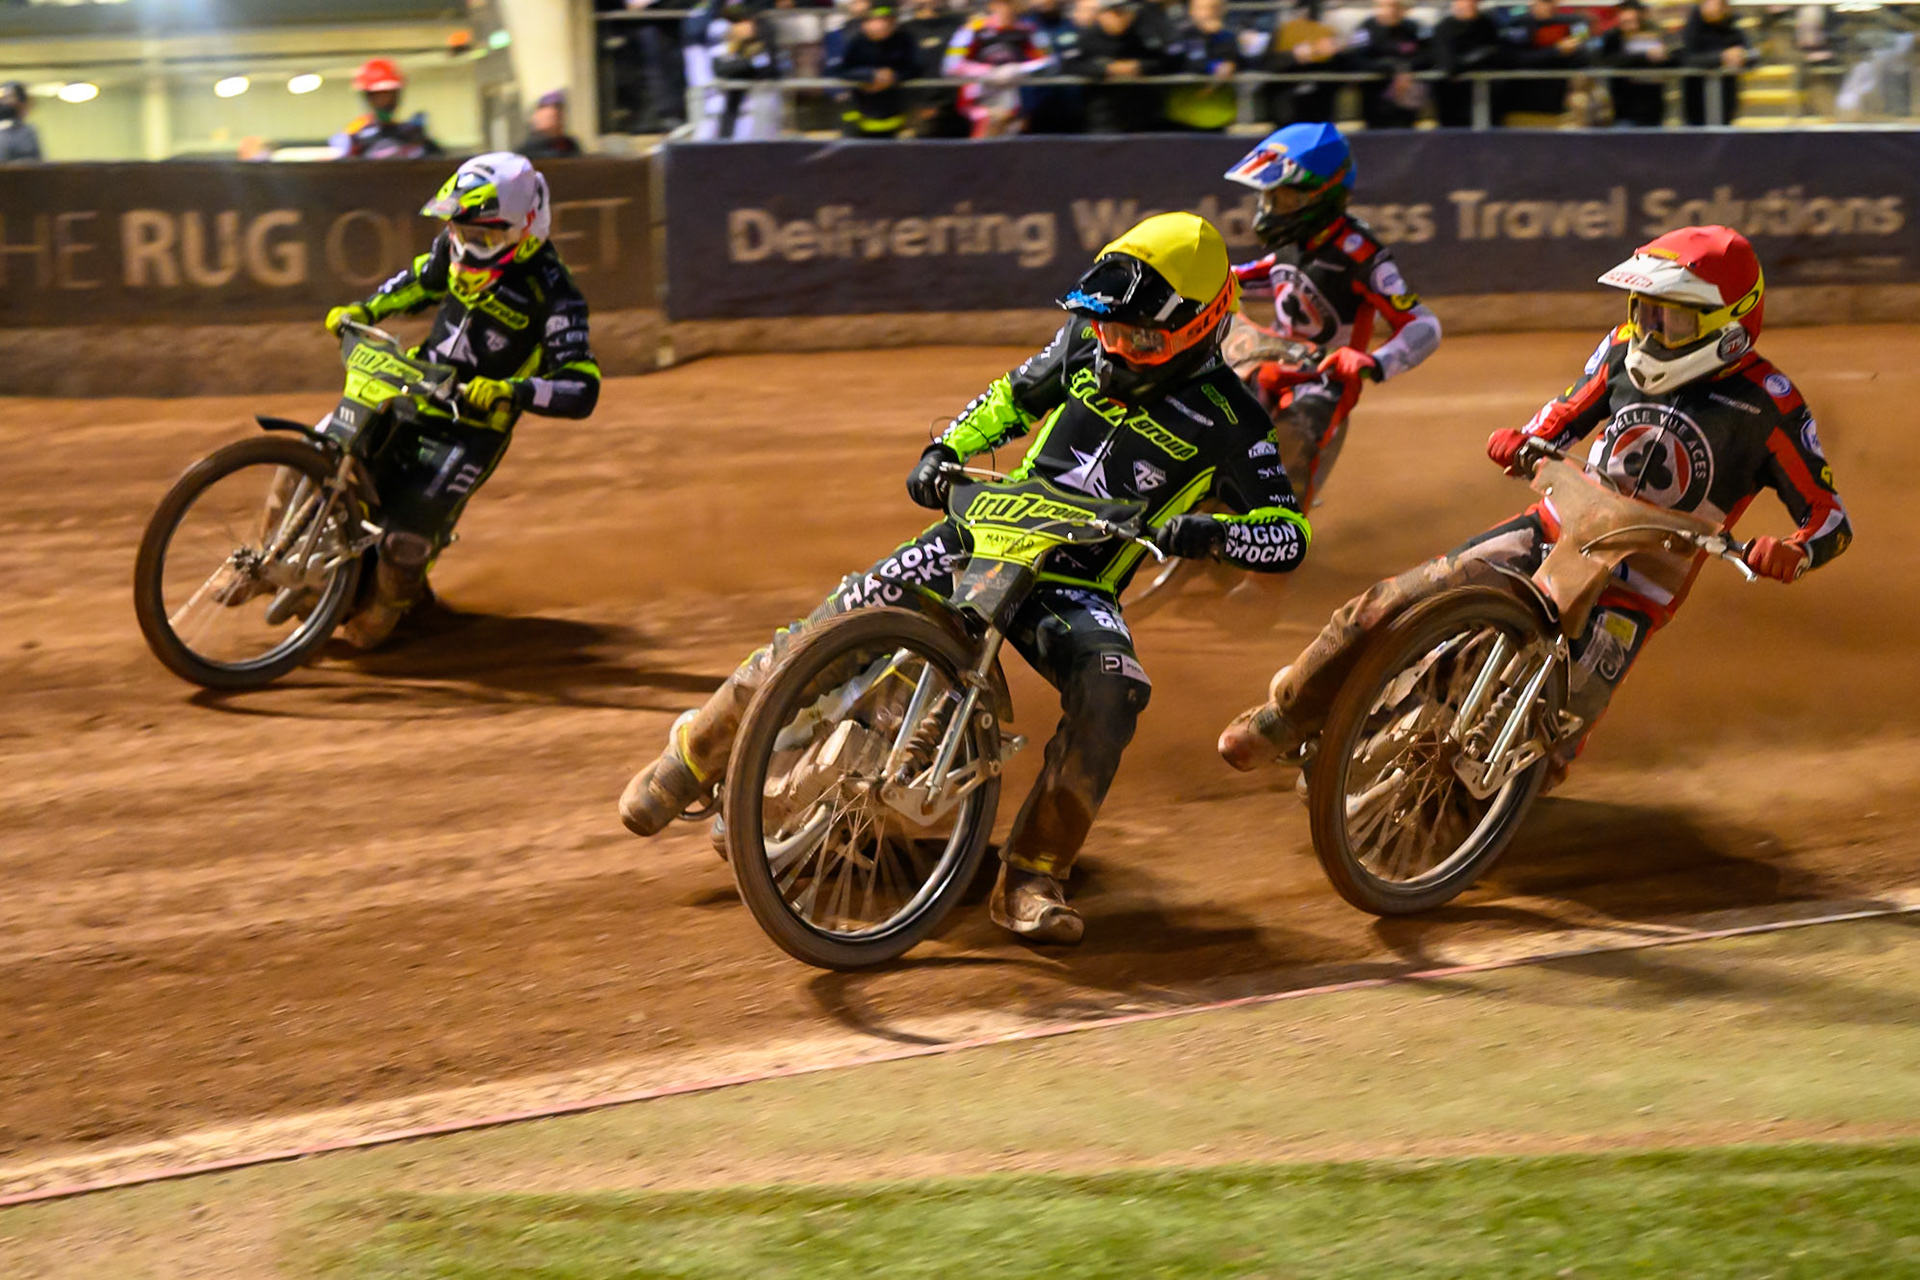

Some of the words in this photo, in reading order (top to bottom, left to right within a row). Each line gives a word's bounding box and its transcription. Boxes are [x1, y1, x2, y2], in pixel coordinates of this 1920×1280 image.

[120, 208, 307, 288] RUG
[729, 200, 1056, 268] Delivering
[1071, 194, 1258, 249] Wld
[1449, 185, 1628, 240] Travel
[1641, 184, 1905, 238] Solutions
[1610, 410, 1651, 437] BELLE
[1660, 412, 1689, 436] VUE
[1687, 439, 1707, 479] ACES
[1135, 464, 1164, 489] 75
[1225, 541, 1299, 564] SHOCKS
[1228, 521, 1298, 545] HAGON
[843, 536, 947, 611] HAGON
[863, 553, 956, 608] HOCKS
